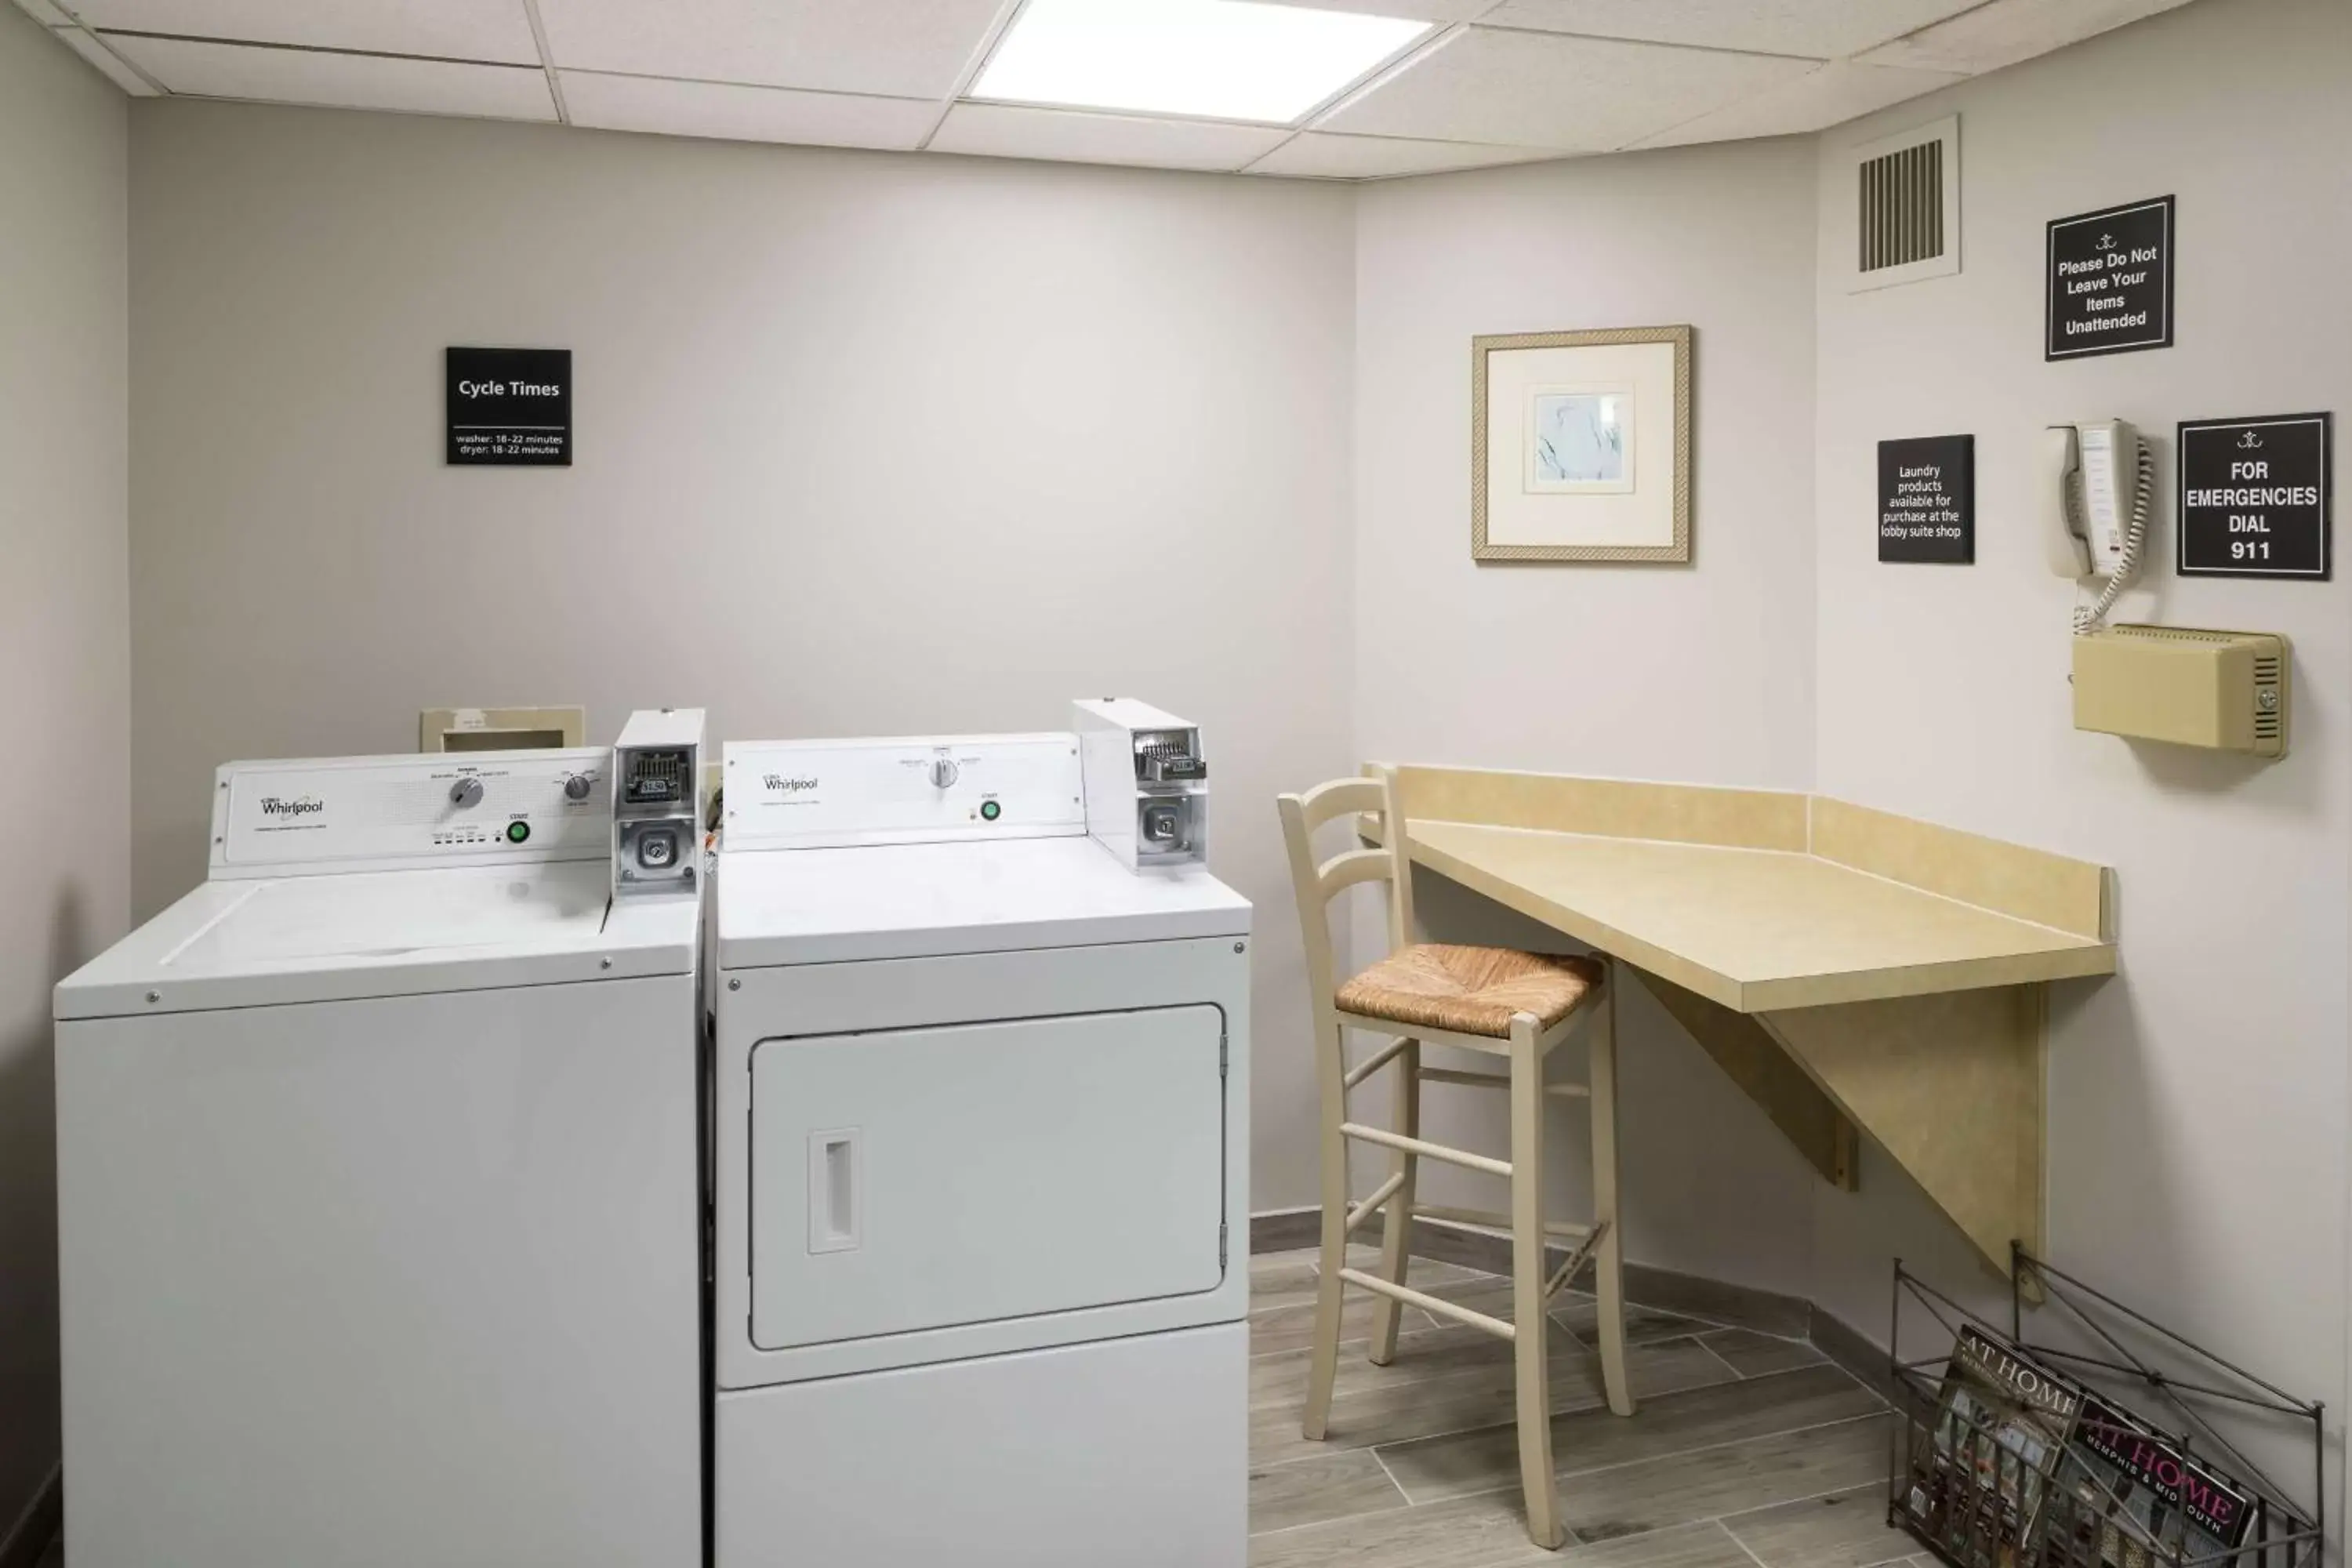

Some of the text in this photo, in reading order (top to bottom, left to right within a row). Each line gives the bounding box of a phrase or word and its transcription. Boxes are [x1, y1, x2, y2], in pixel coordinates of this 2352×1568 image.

[2058, 245, 2157, 276] Please Do Not
[2067, 271, 2147, 295] Leave Your
[2086, 295, 2125, 312] Items
[2065, 310, 2147, 335] Unattended
[459, 380, 560, 399] Cycle Times
[456, 434, 493, 444] washer:
[525, 434, 564, 445] minutes
[521, 445, 560, 455] minutes
[1899, 464, 1940, 479] Laundry
[2230, 461, 2268, 480] FOR
[1897, 480, 1942, 495] products
[2187, 486, 2318, 507] EMERGENCIES
[1889, 493, 1951, 507] available for
[1882, 509, 1959, 524] purchase at the
[2229, 514, 2270, 532] DIAL
[1881, 524, 1962, 539] lobby suite shop
[2230, 541, 2270, 559] 911
[765, 778, 818, 792] Whirlpool
[263, 800, 322, 815] Whirlpool
[1966, 1335, 1995, 1365] AT
[1997, 1356, 2078, 1414] HOME
[2086, 1433, 2139, 1475] MEMPHIS
[2184, 1503, 2222, 1534] OUTH
[2131, 1440, 2234, 1524] HOME
